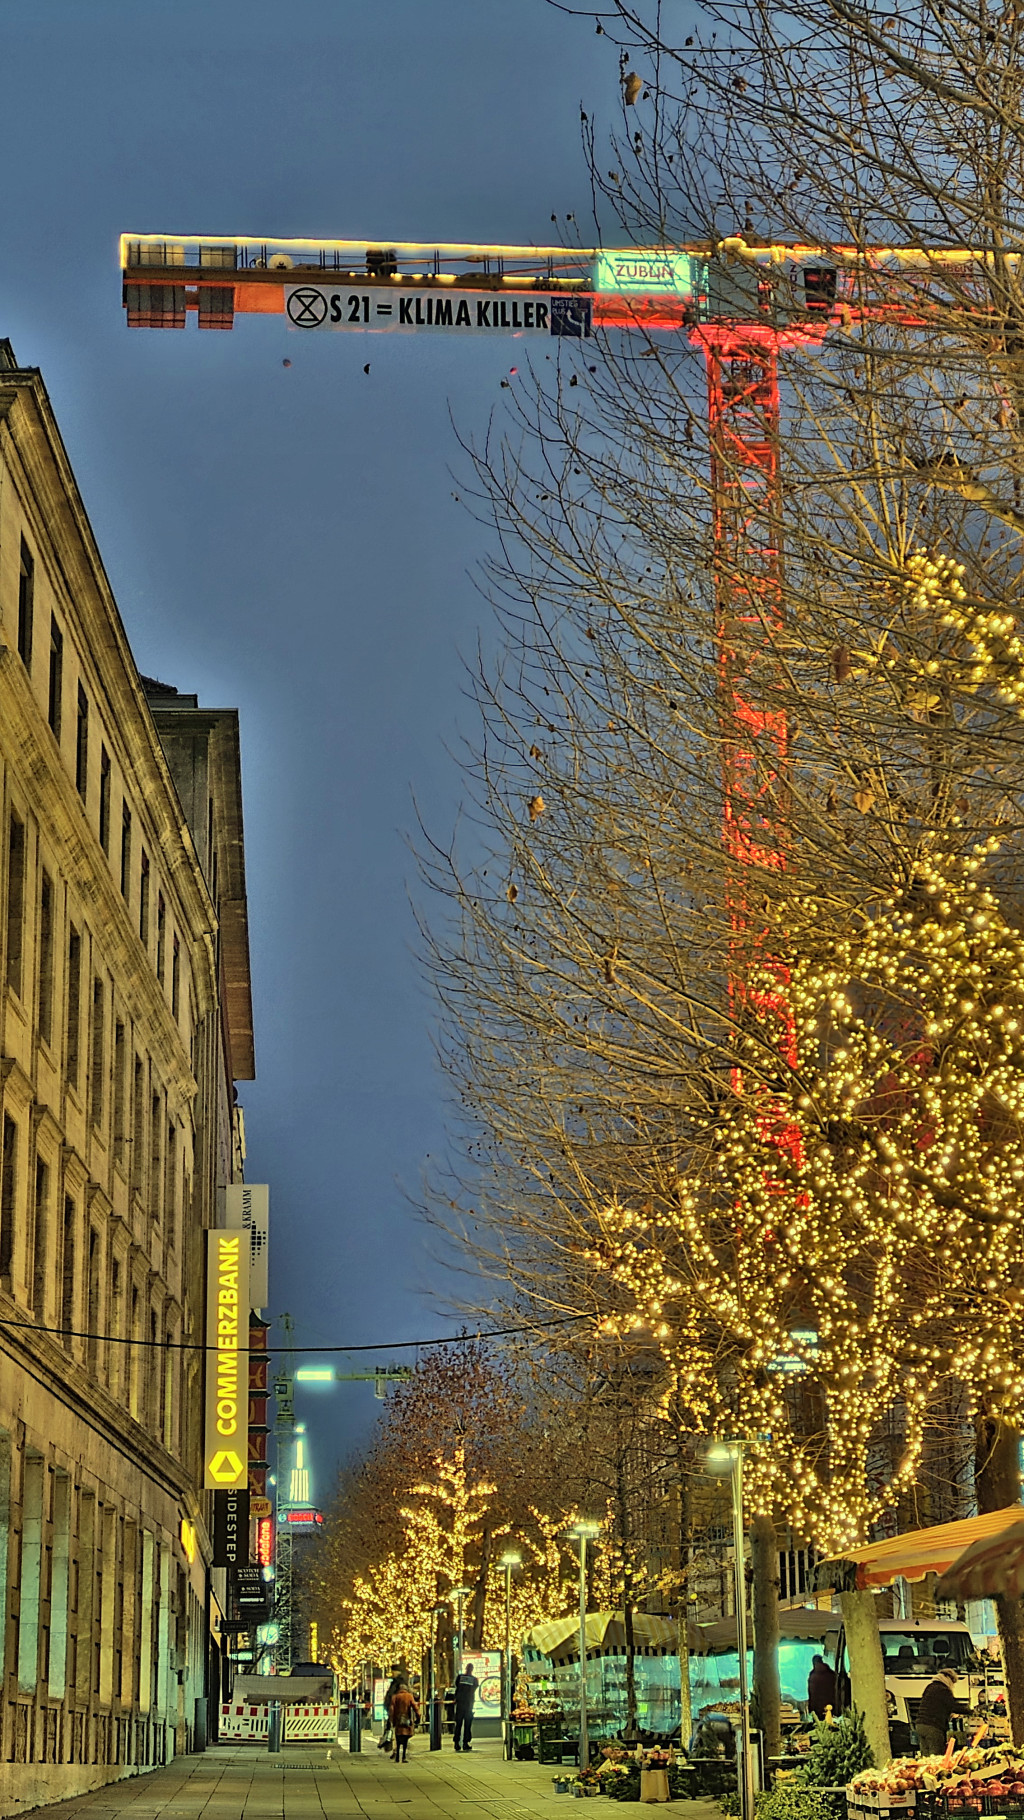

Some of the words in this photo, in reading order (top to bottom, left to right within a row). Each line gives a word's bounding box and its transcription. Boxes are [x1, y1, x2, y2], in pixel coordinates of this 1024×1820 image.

[242, 1190, 251, 1221] KRAMM
[216, 1237, 239, 1436] COMMERZBANK
[226, 1489, 237, 1562] SIDESTEP
